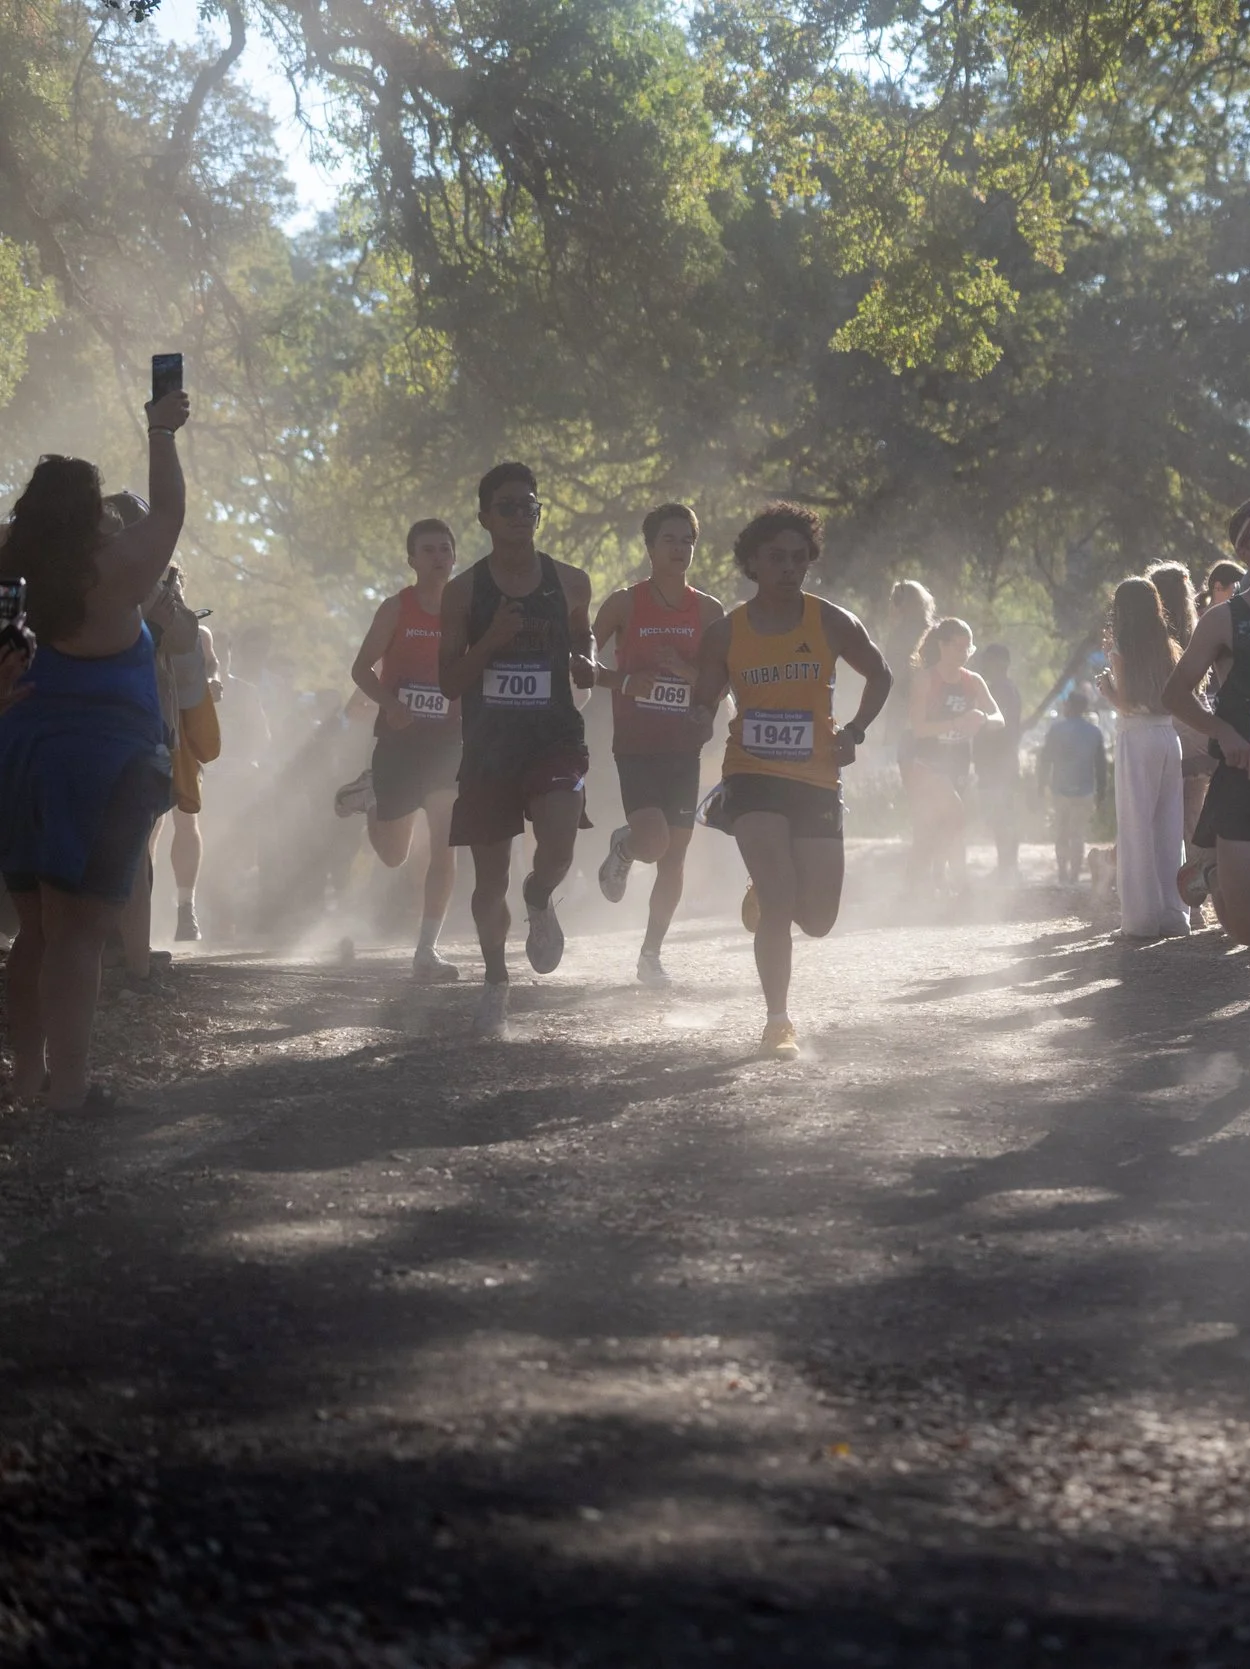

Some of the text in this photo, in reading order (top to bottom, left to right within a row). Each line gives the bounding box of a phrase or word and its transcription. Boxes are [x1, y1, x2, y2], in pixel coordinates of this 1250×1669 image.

[639, 627, 696, 638] MCCLATCHY
[741, 662, 821, 685] YUBA CITY
[497, 675, 537, 695] 700
[650, 686, 686, 703] 069
[406, 693, 444, 711] 1048
[752, 724, 806, 745] 1947
